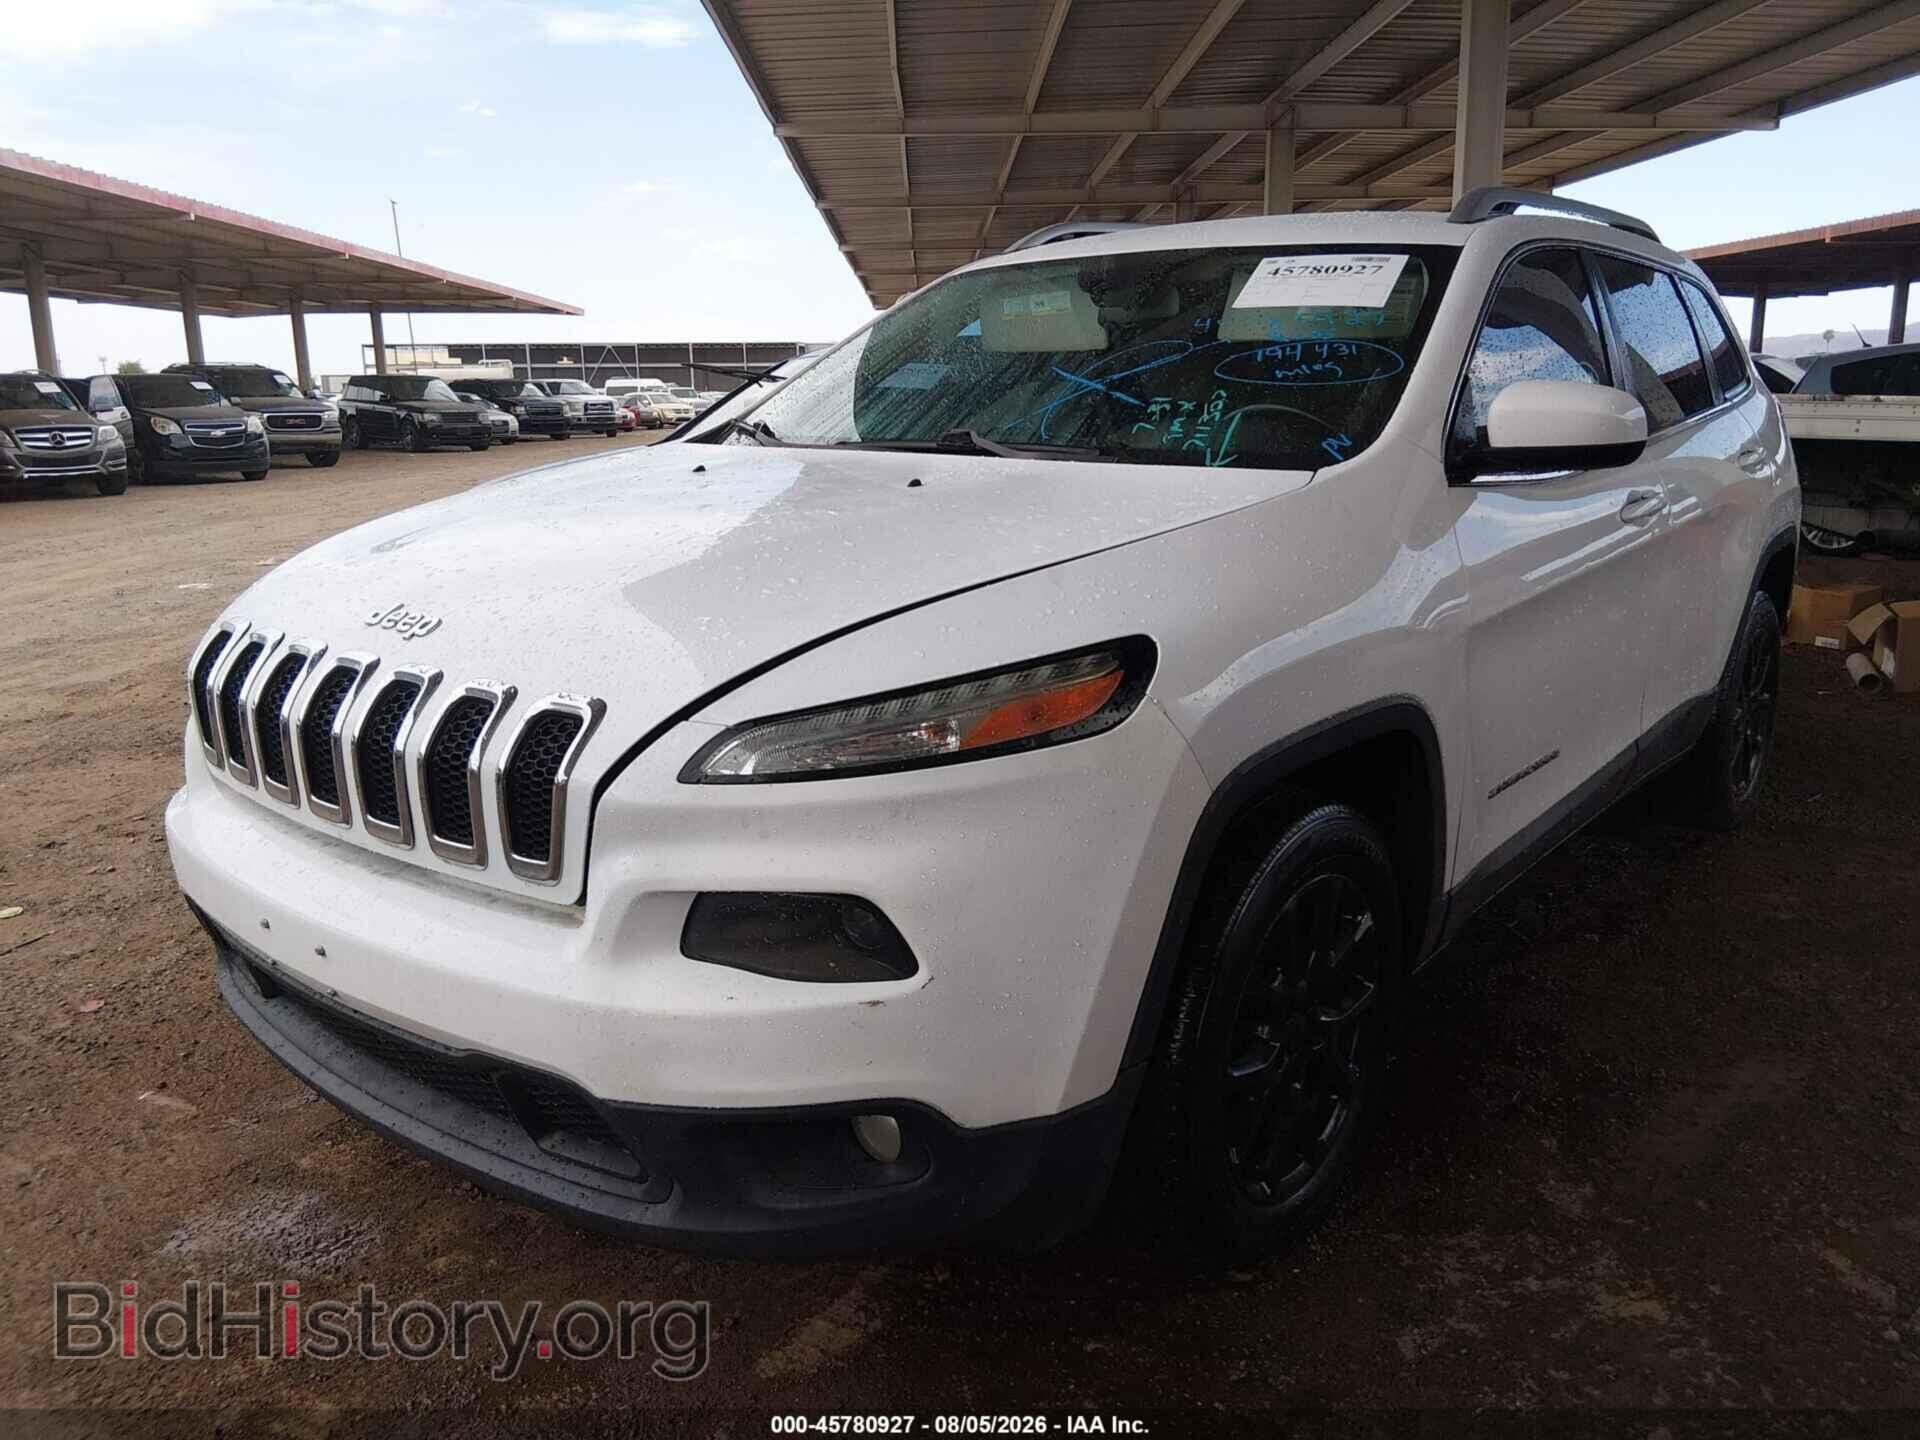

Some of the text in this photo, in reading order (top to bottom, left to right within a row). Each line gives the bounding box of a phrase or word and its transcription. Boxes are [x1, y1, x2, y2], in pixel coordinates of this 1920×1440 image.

[1266, 264, 1385, 277] 45780927
[1314, 343, 1358, 360] 431
[364, 602, 444, 641] Jeep
